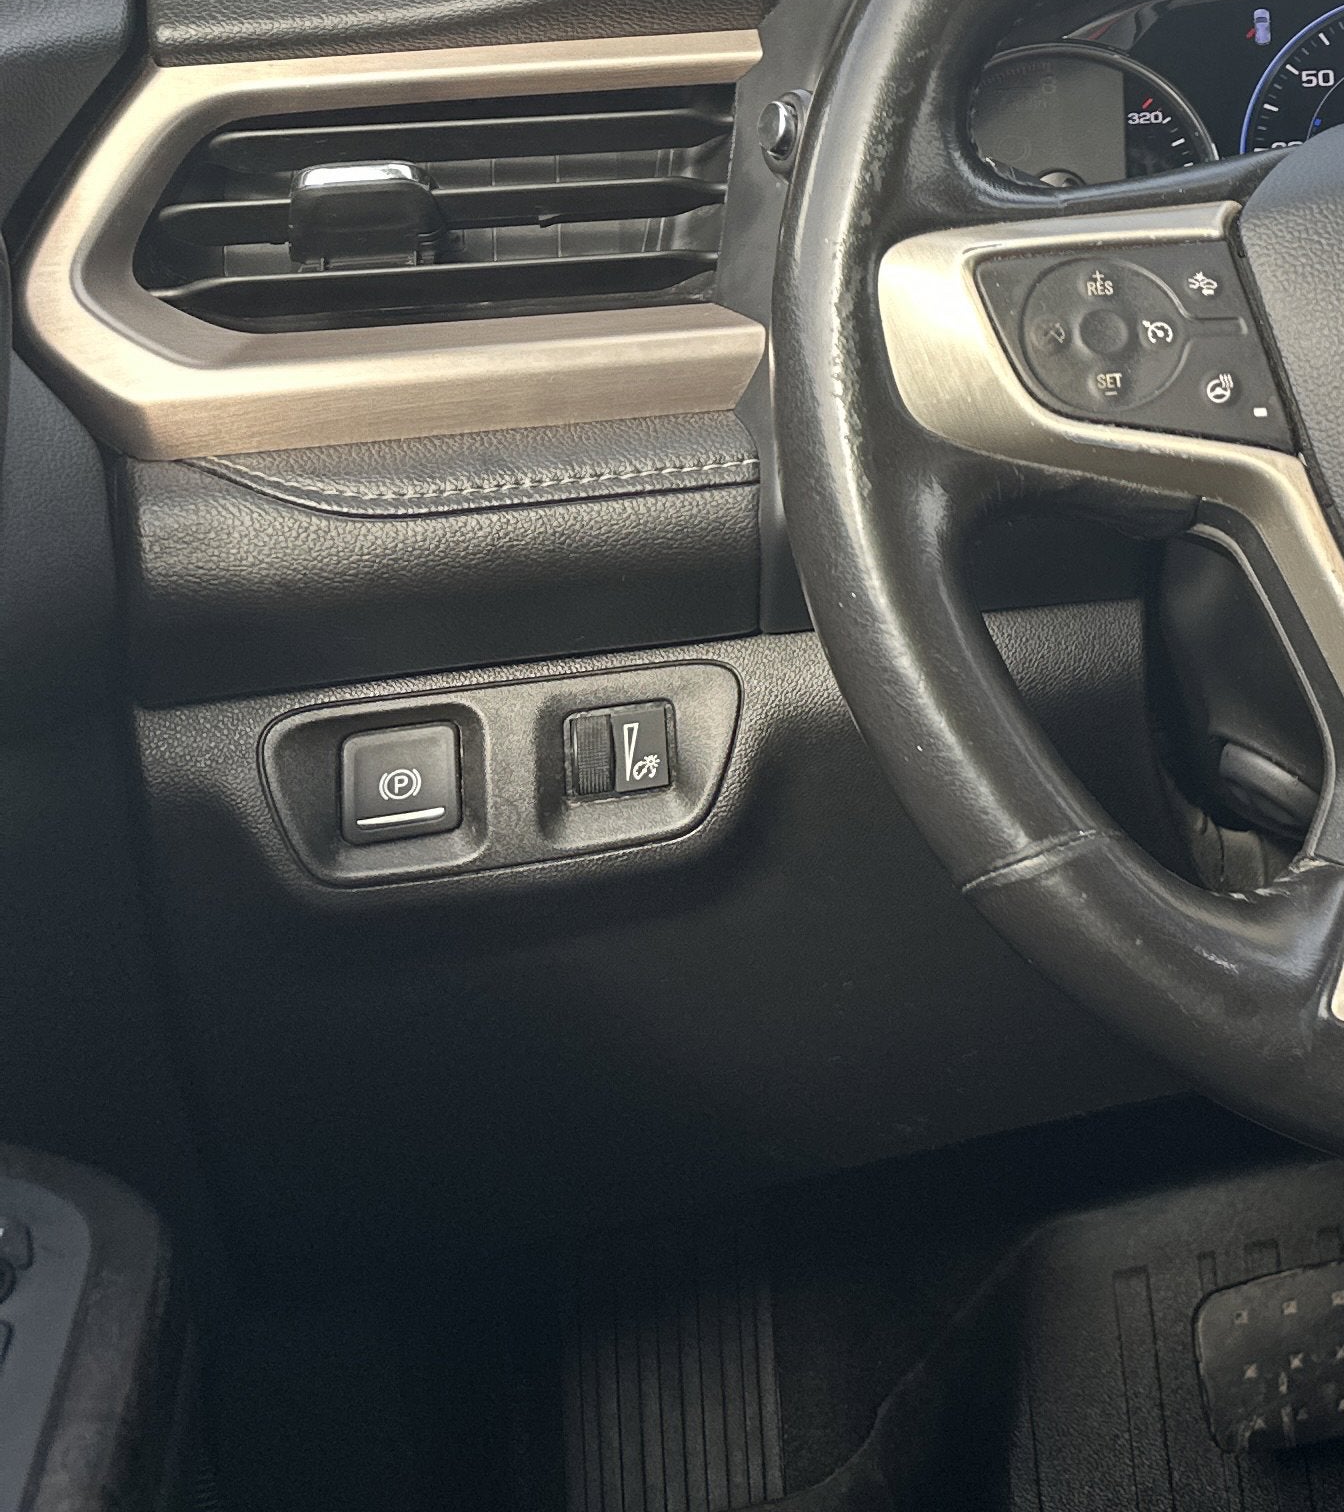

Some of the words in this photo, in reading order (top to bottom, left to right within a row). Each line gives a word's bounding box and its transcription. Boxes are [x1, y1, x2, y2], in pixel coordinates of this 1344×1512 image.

[1301, 69, 1335, 88] 50
[1127, 111, 1163, 125] 320
[1087, 281, 1114, 296] RES
[1096, 373, 1122, 389] SET
[394, 775, 408, 793] P
